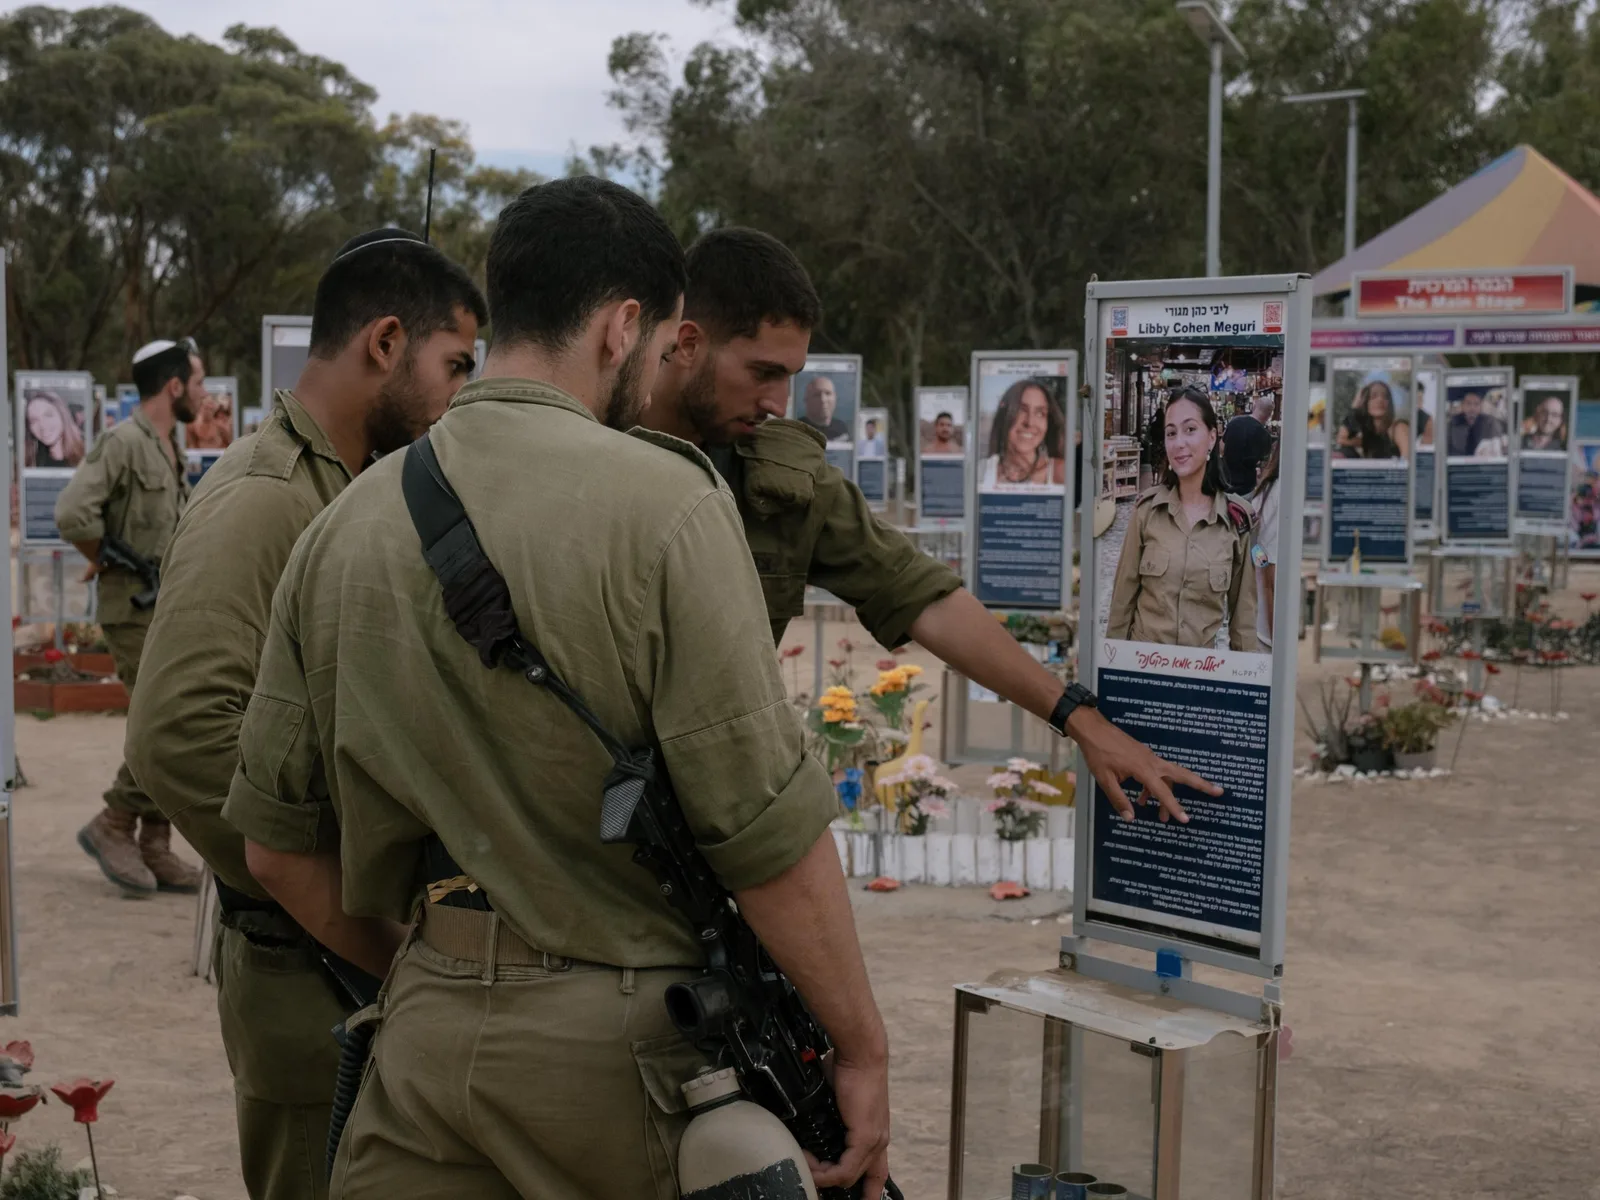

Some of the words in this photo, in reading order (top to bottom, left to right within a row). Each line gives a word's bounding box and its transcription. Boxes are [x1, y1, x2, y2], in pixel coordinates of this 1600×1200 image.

[1395, 296, 1426, 310] The
[1431, 294, 1472, 308] Main
[1474, 294, 1526, 310] Stage
[1165, 306, 1189, 317] מגורי
[1192, 306, 1207, 318] כהן
[1210, 304, 1229, 315] ליבי
[1138, 323, 1170, 336] Libby
[1174, 322, 1211, 333] Cohen
[1214, 321, 1256, 334] Meguri
[1135, 651, 1170, 669] בקטנה"
[1172, 656, 1192, 670] אמא
